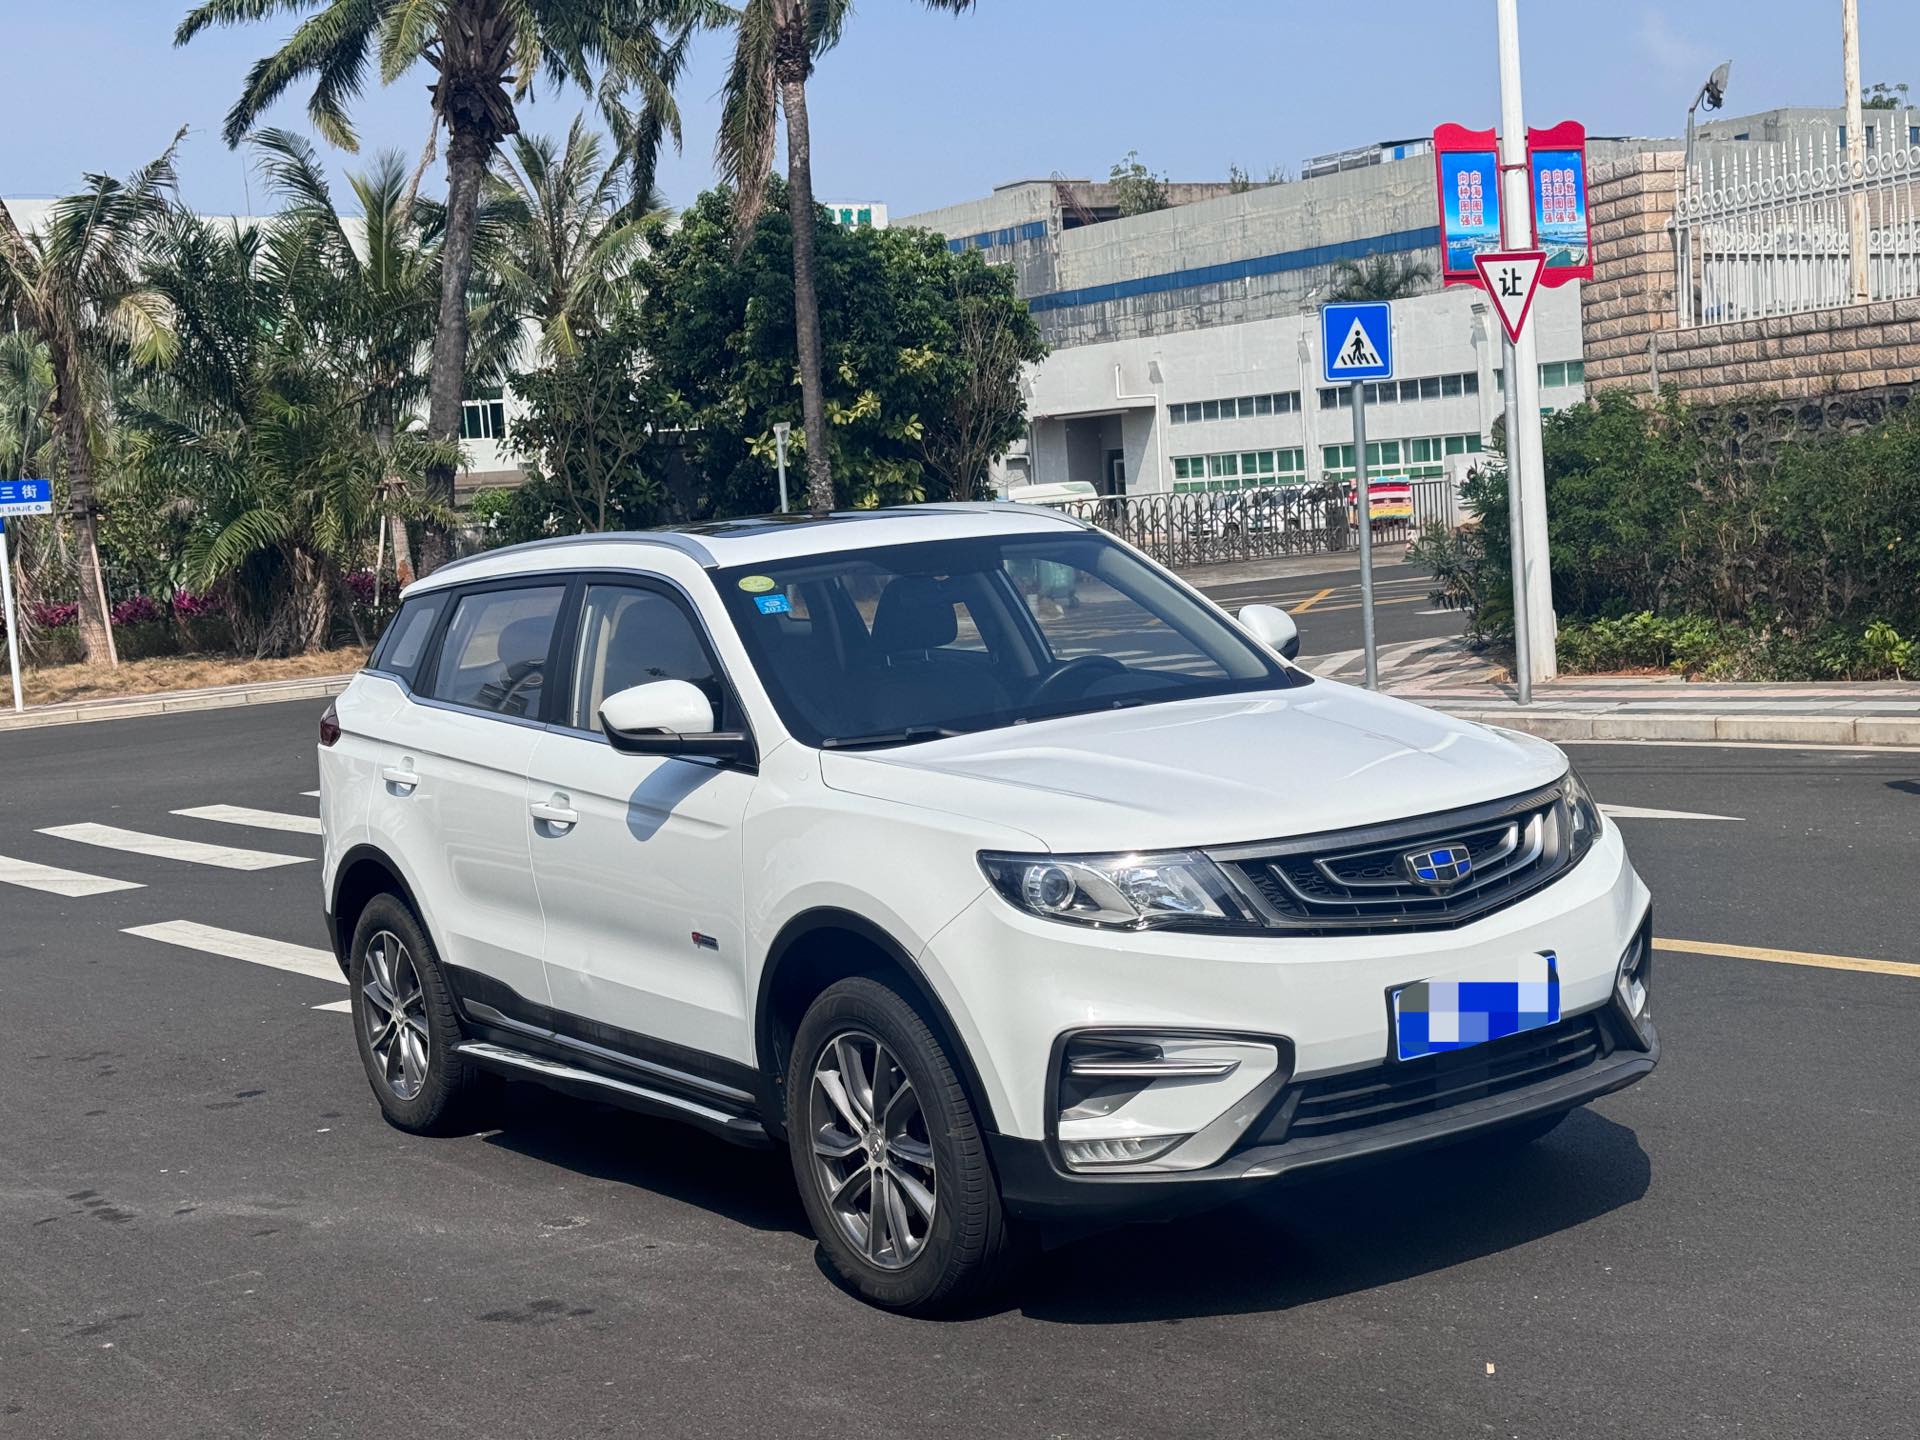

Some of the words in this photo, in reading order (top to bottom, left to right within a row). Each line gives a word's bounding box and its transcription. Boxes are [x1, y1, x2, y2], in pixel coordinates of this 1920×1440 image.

[1471, 171, 1483, 226] 向海图强
[1541, 169, 1553, 223] 向天图强
[1499, 268, 1523, 297] 让
[0, 484, 37, 499] 三街
